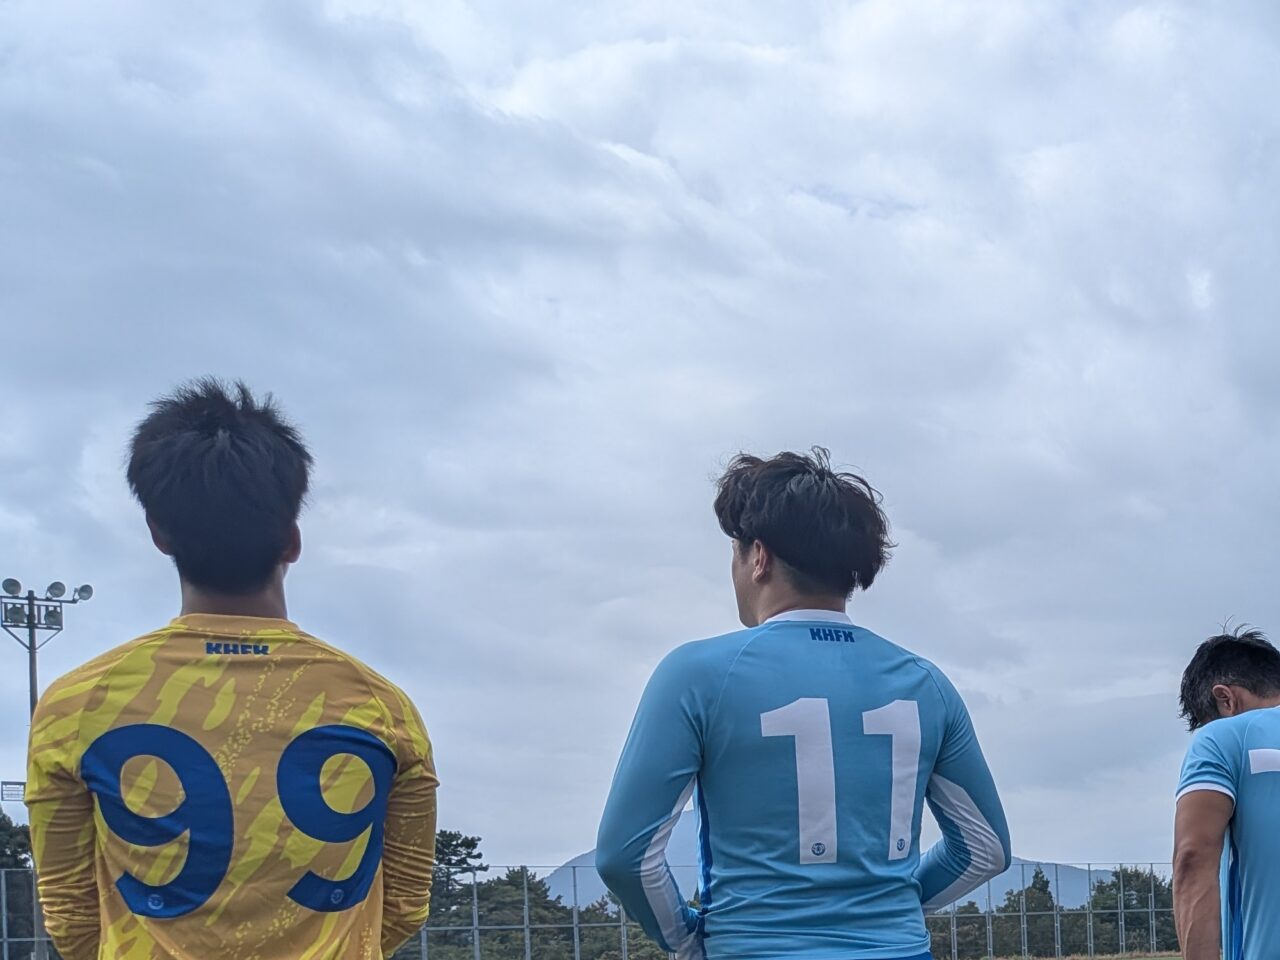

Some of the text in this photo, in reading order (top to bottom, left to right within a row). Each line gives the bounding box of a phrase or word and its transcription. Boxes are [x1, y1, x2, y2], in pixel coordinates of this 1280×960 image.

[808, 623, 855, 643] KHFK
[81, 723, 398, 919] 99
[760, 697, 922, 864] 11
